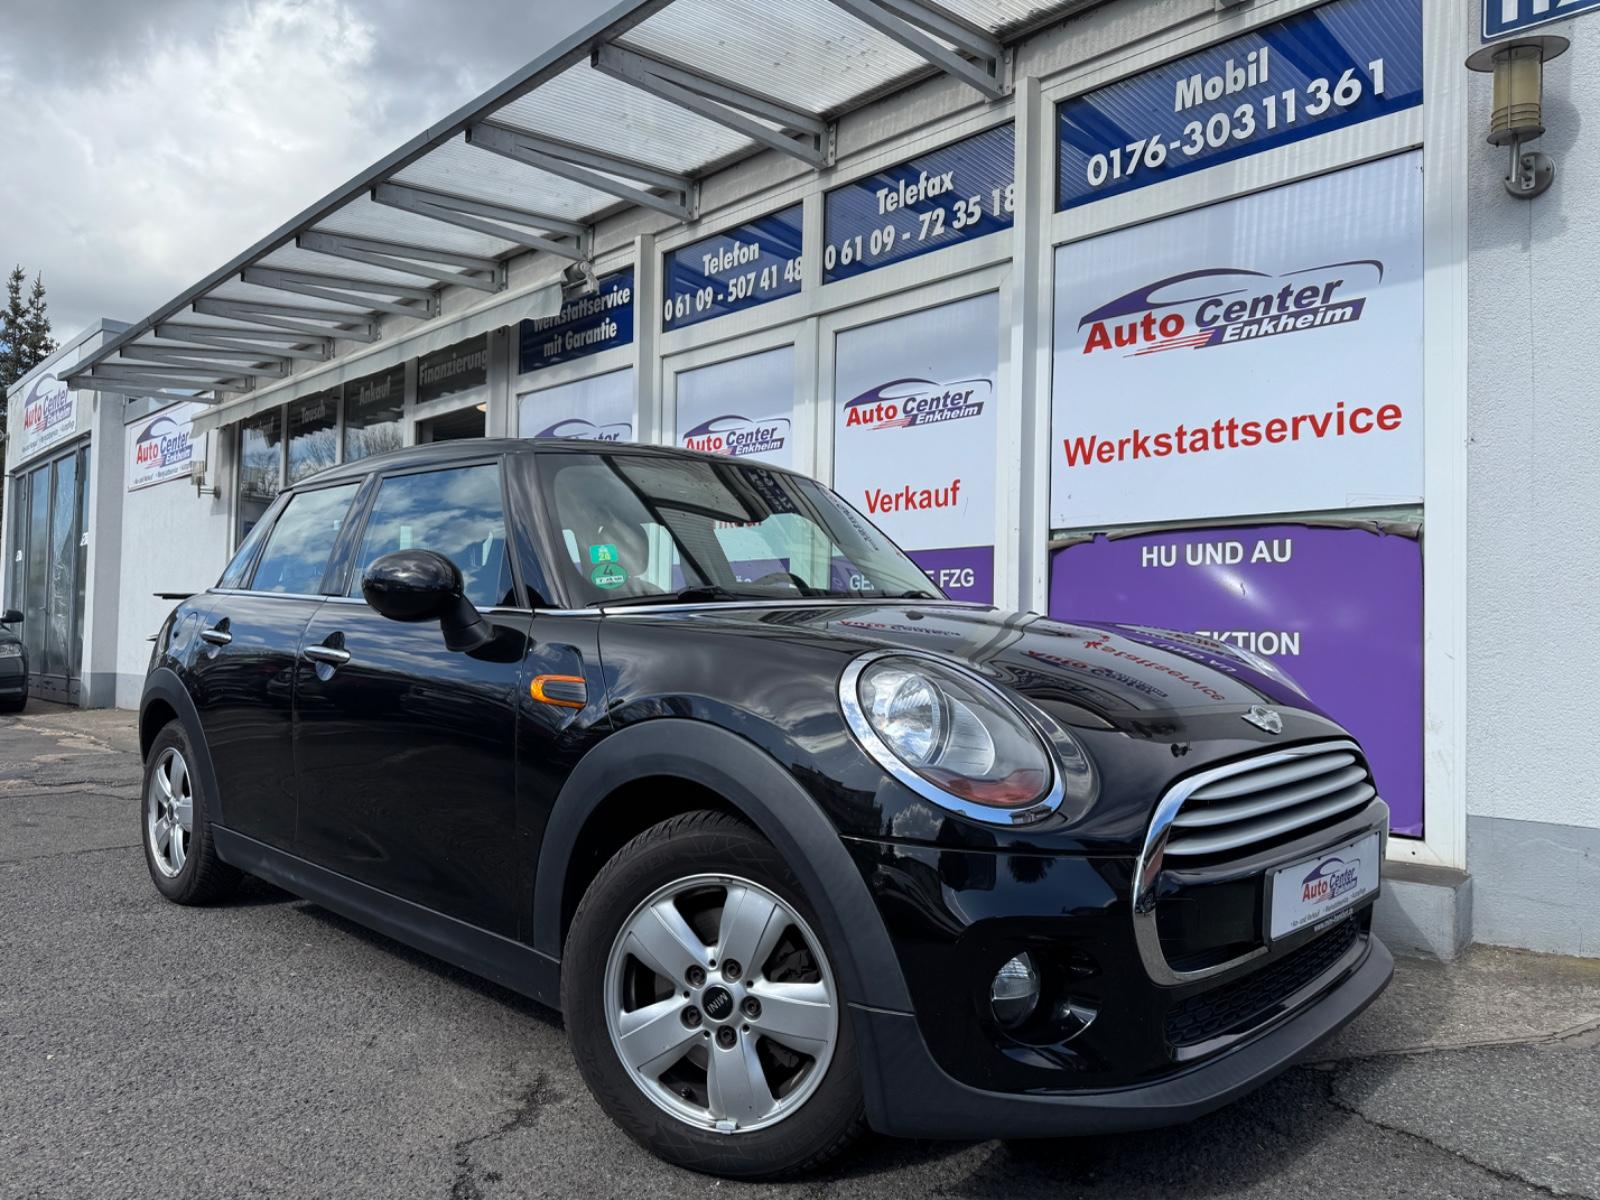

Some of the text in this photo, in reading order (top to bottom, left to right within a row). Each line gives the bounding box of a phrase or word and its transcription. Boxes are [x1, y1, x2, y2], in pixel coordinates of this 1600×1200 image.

[1174, 46, 1268, 113] Mobil
[876, 171, 954, 215] Telefax
[702, 241, 759, 277] Telefon
[727, 271, 757, 303] 507
[1083, 279, 1344, 355] Auto Center
[1222, 304, 1353, 343] Enkheim
[543, 317, 618, 358] mit Garantie
[419, 349, 488, 386] Finanzierung
[846, 389, 974, 428] Auto Center
[915, 406, 978, 425] Enkheim
[686, 427, 778, 452] Auto Center
[736, 441, 781, 454] Enkheim
[1064, 400, 1402, 467] Werkstattservice
[865, 479, 961, 514] Verkauf
[1142, 539, 1293, 568] HU UND AU
[939, 567, 975, 588] FZG
[1302, 880, 1328, 903] Auto
